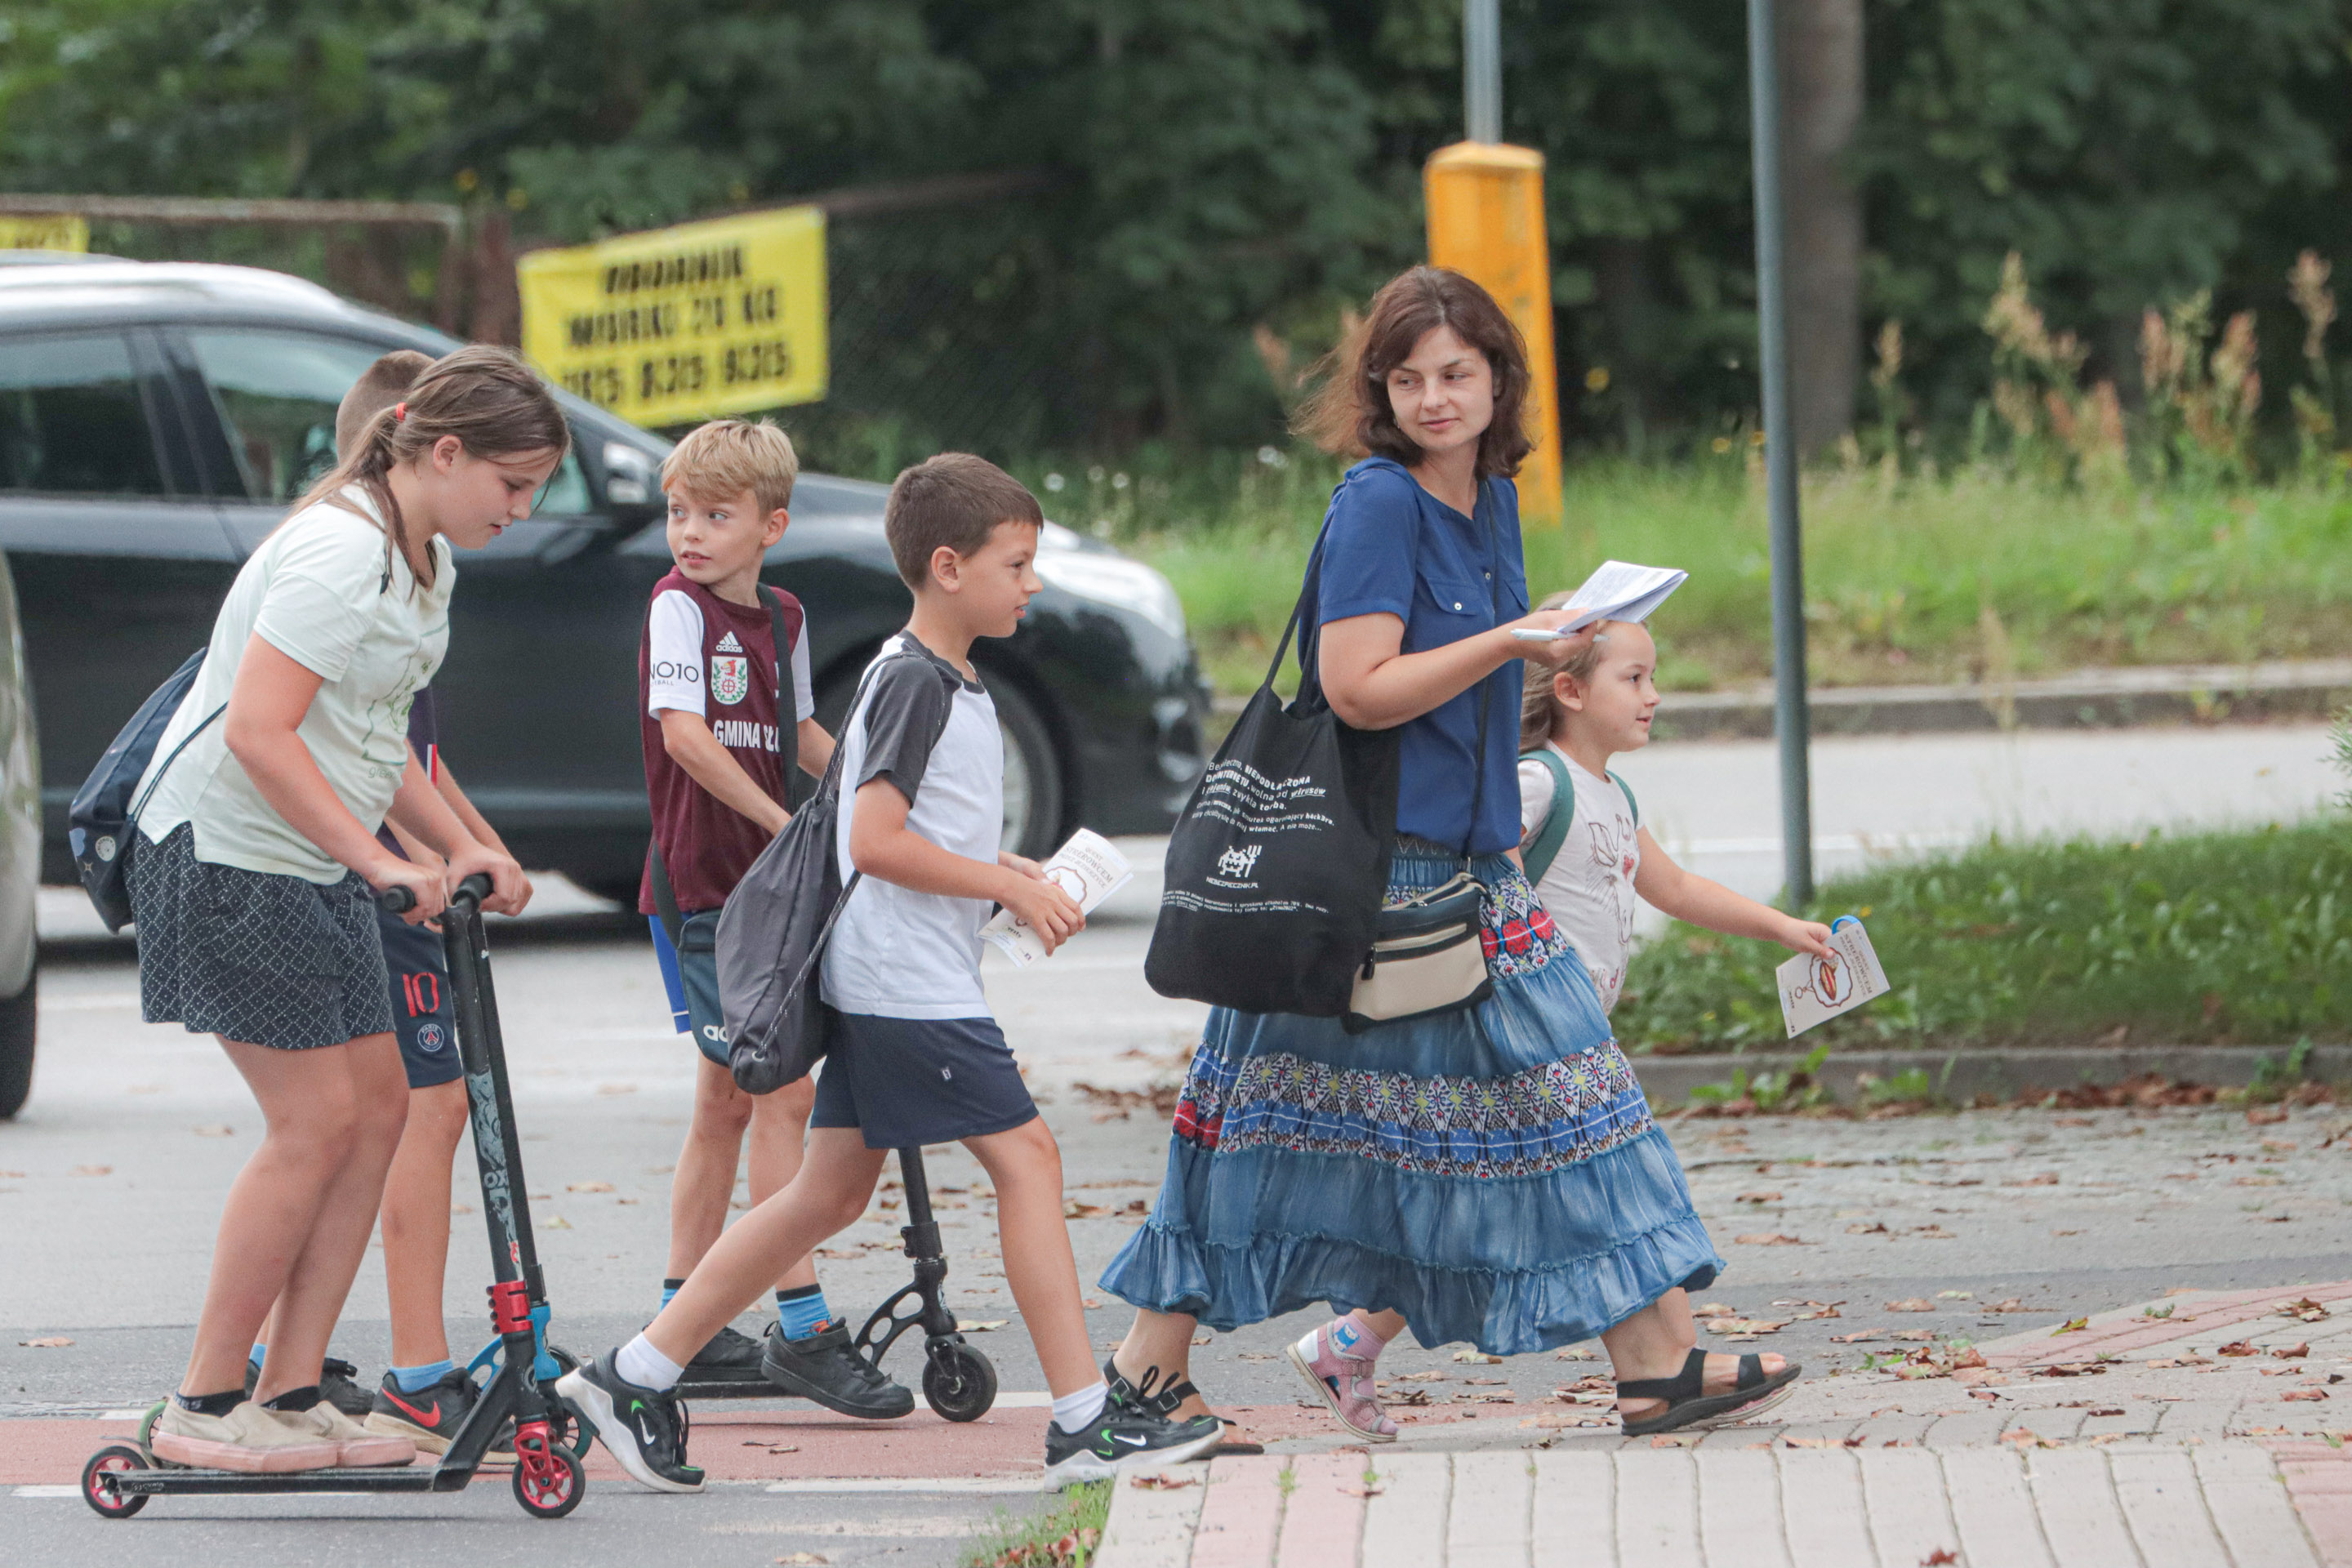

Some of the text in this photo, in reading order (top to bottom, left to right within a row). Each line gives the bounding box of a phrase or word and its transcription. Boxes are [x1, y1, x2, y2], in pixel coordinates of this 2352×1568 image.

[713, 719, 760, 749] GMINA
[1250, 785, 1275, 801] wolna
[1290, 787, 1326, 799] wirusów
[1259, 801, 1286, 811] torba.
[403, 972, 439, 1017] 10
[421, 1024, 439, 1033] PARIS
